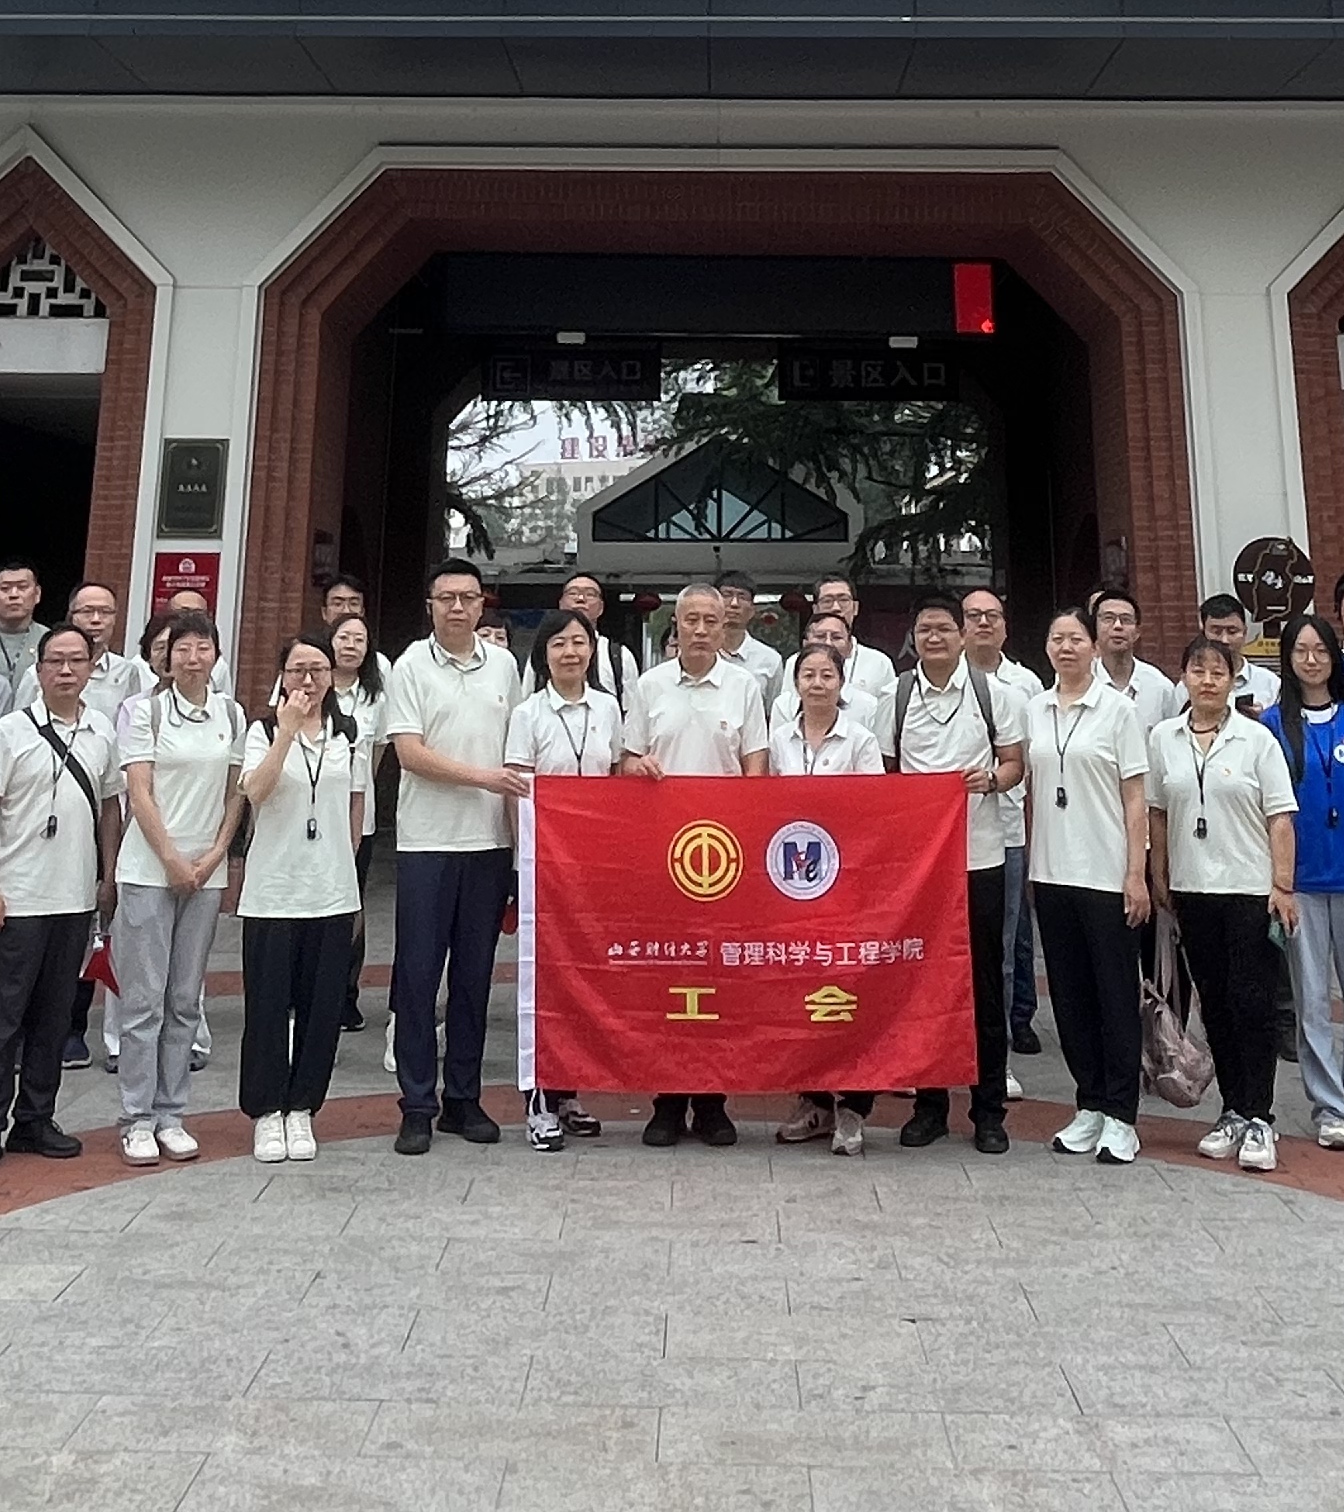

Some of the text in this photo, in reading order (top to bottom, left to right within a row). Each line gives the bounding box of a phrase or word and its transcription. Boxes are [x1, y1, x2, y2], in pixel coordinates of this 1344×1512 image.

[828, 359, 947, 388] 景区入口
[720, 936, 925, 968] 管理科学与工程学院
